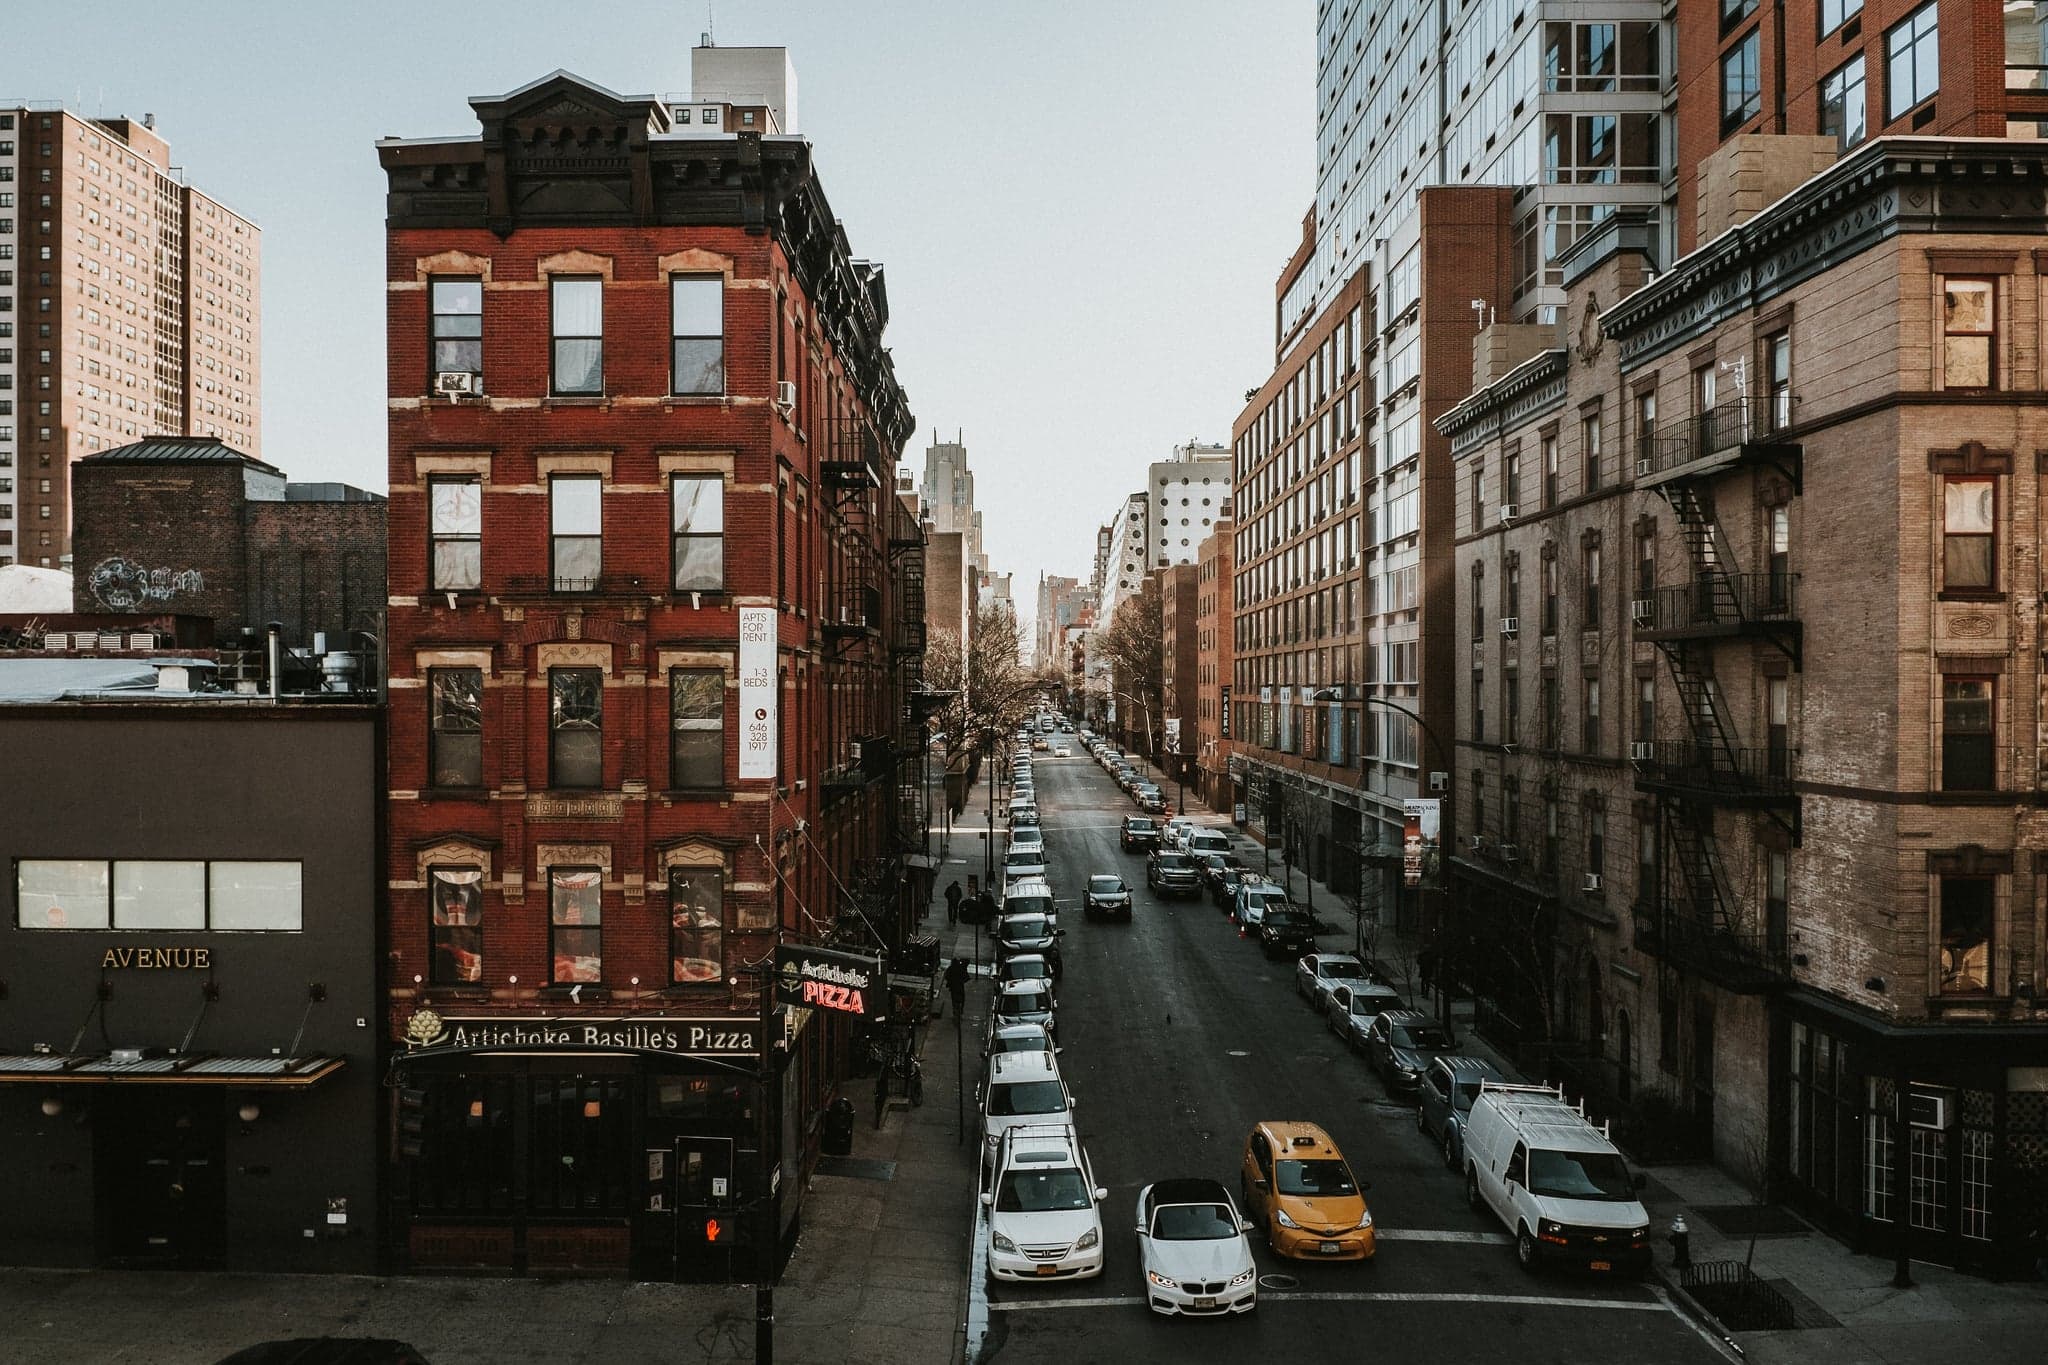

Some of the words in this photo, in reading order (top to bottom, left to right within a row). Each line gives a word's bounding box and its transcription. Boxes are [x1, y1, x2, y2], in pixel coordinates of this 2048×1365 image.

[743, 612, 767, 622] APTS
[743, 622, 763, 632] FOR
[743, 632, 767, 642] RENT
[754, 668, 768, 677] 1-3
[743, 678, 768, 687] BEDS
[749, 723, 768, 732] 646
[750, 732, 768, 741] 328
[748, 742, 768, 751] 1917
[102, 948, 210, 968] AVENUE
[801, 959, 869, 989] Artichoke
[803, 981, 865, 1014] PIZZA
[454, 1025, 570, 1048] Artichoke
[583, 1026, 678, 1049] Basille's
[690, 1027, 753, 1049] Pizza
